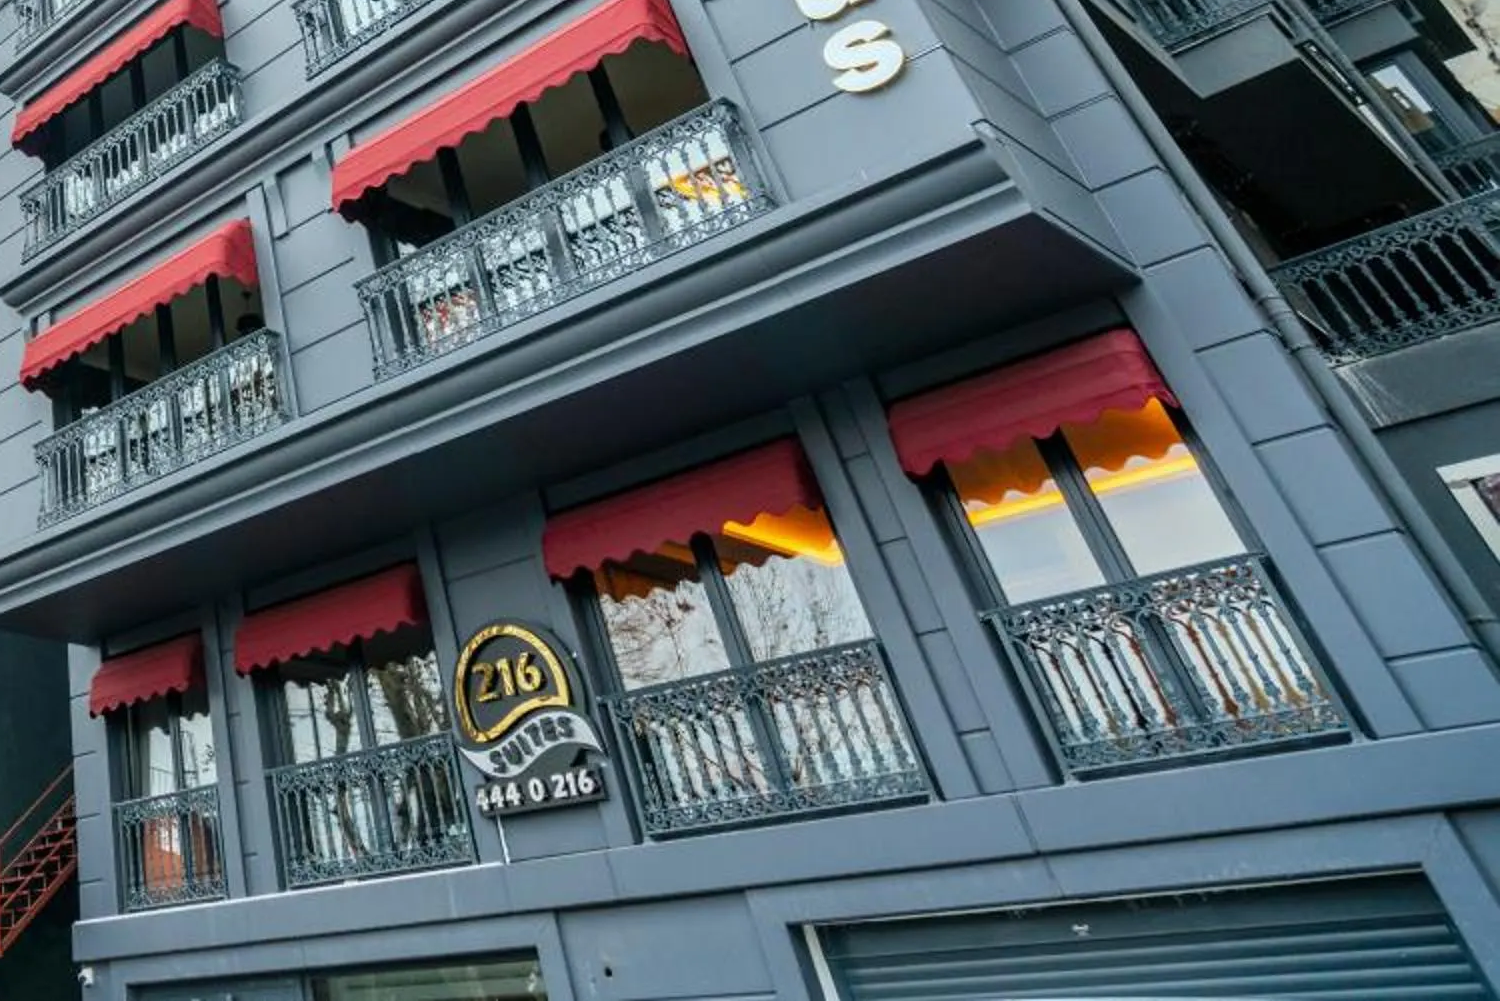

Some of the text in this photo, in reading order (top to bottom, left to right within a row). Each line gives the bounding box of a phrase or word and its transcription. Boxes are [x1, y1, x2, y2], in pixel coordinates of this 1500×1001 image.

[472, 652, 542, 702] 216
[489, 716, 575, 774] SUITES
[476, 768, 594, 812] 444 0 216
